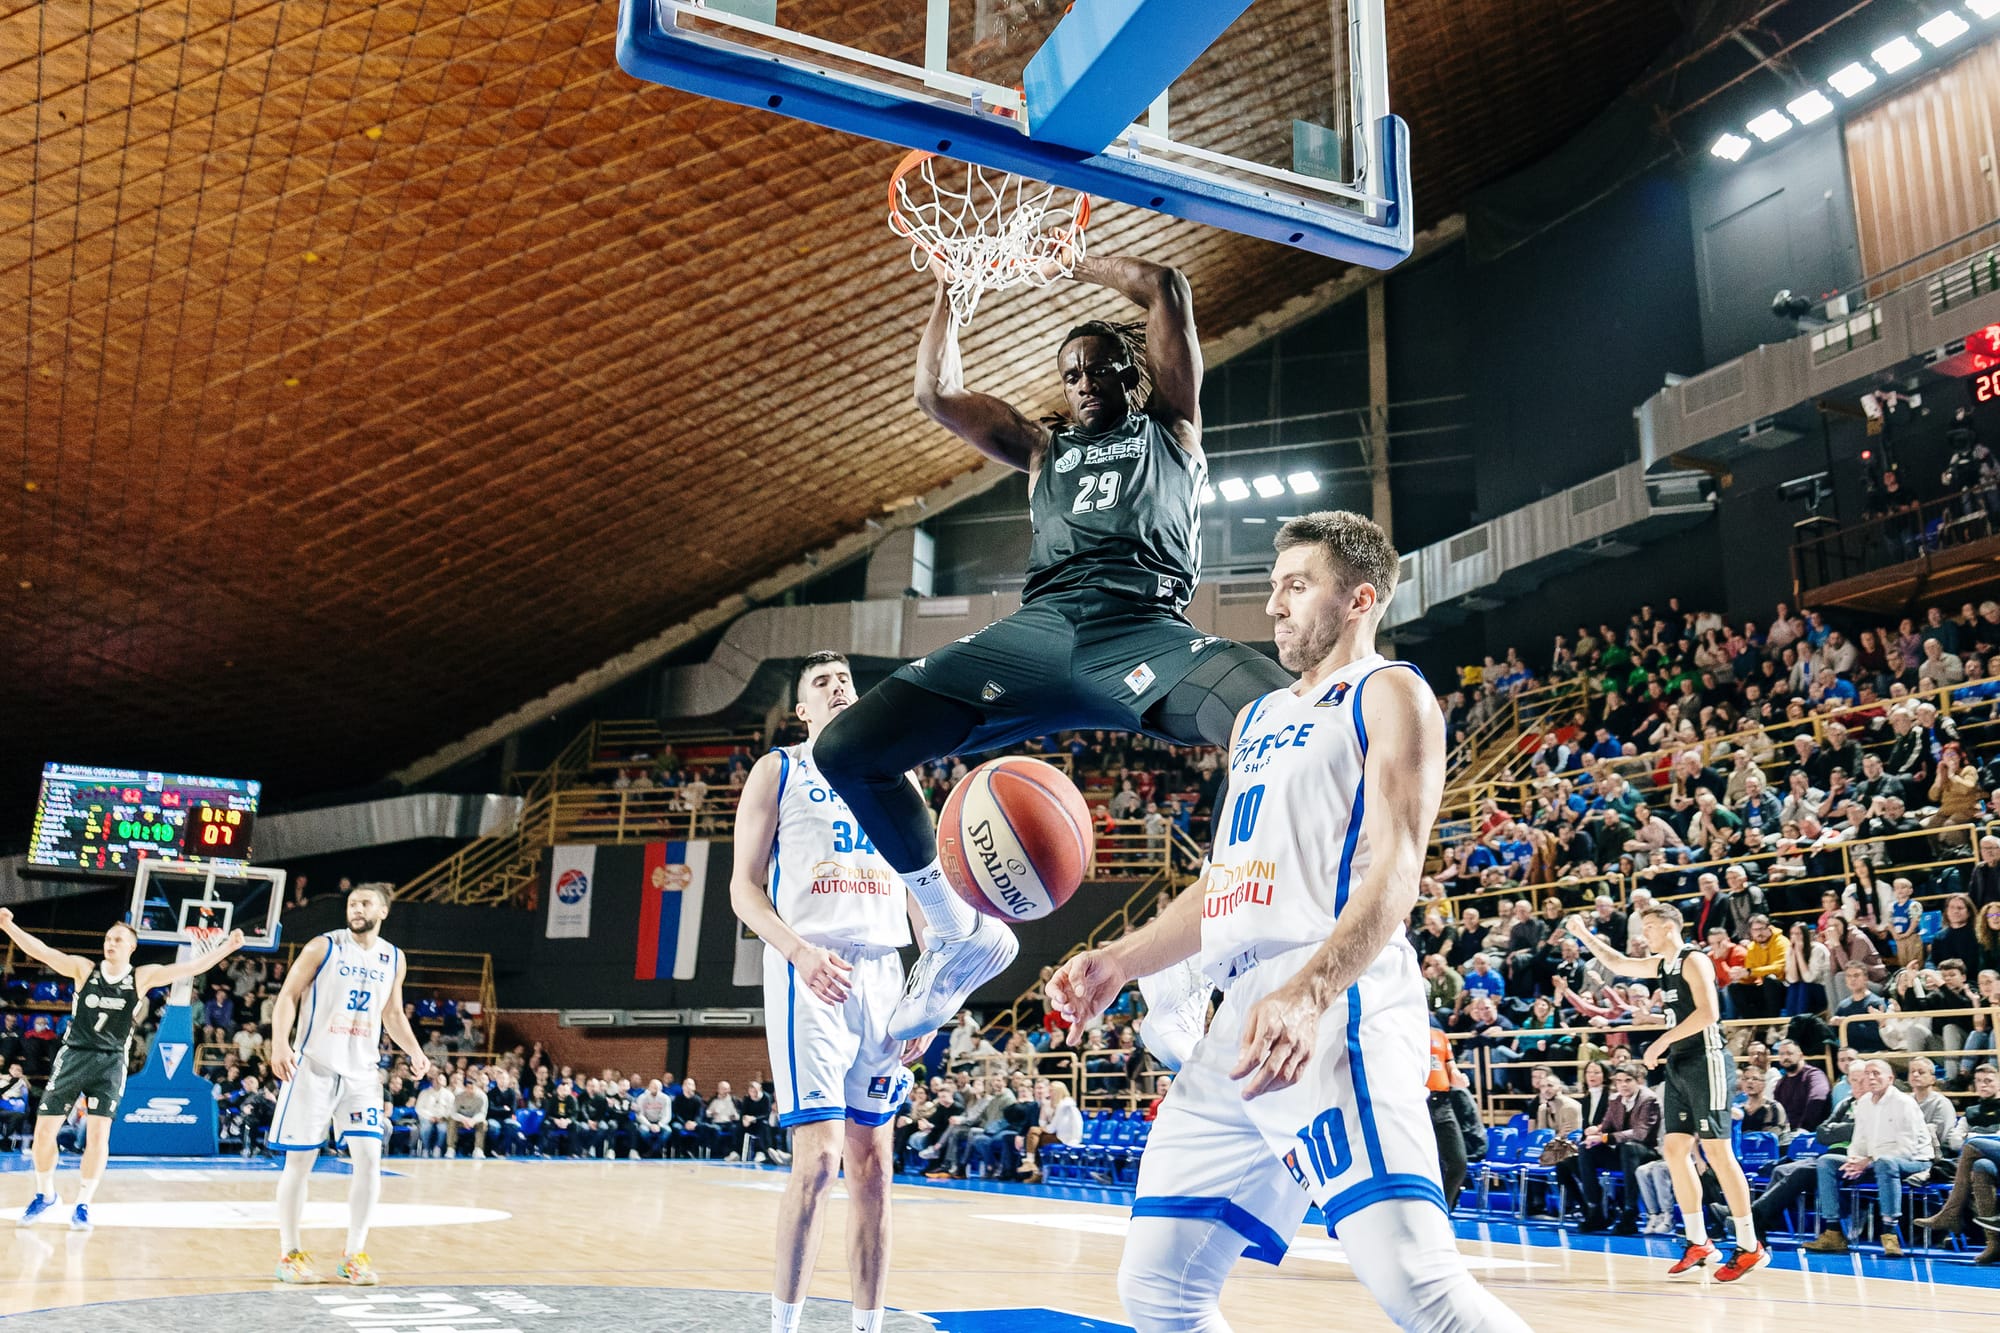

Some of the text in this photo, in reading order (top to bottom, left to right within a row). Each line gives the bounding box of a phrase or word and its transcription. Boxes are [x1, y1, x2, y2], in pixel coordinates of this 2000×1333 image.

[1072, 471, 1122, 514] 29
[1229, 785, 1265, 846] 10
[204, 825, 232, 845] 07
[832, 821, 876, 855] 34
[848, 869, 891, 881] POLOVNI
[969, 820, 1037, 915] SPALDING
[811, 880, 891, 896] AUTOMOBILI
[347, 990, 371, 1012] 32
[1296, 1107, 1352, 1187] 10
